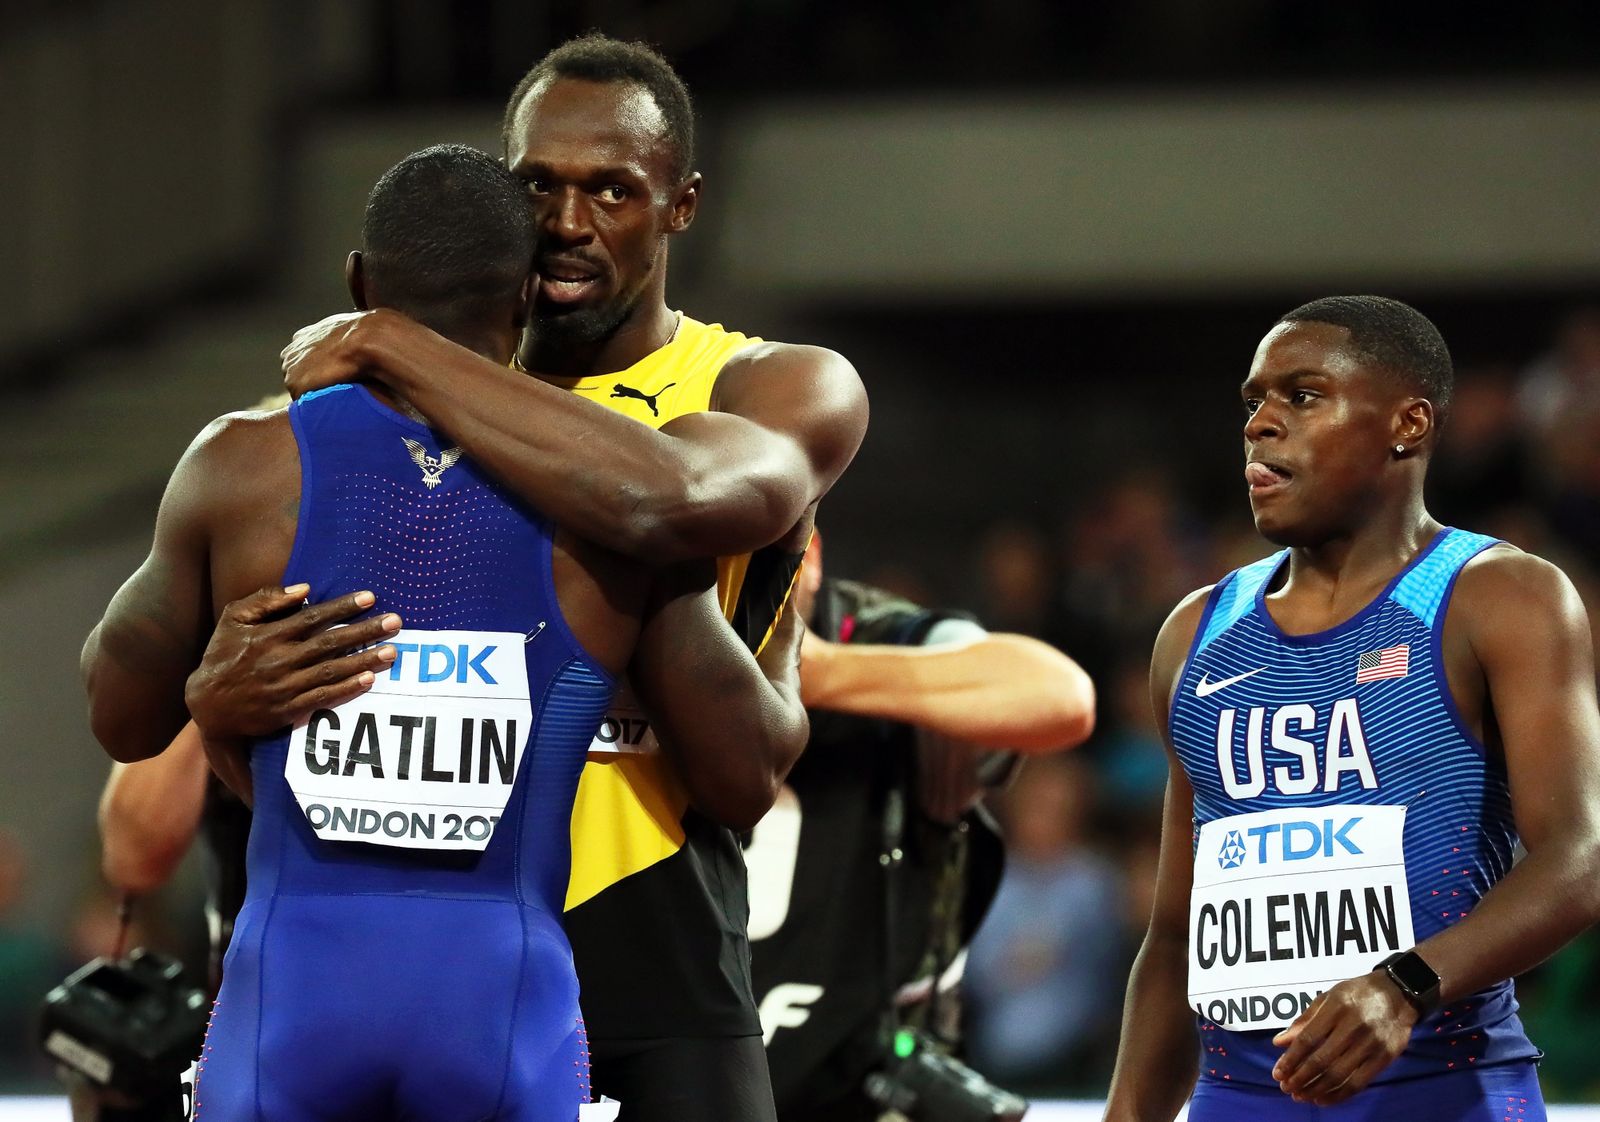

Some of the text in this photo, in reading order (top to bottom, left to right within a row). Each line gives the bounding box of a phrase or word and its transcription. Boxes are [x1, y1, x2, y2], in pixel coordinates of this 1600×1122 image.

[377, 641, 499, 685] TDK
[304, 708, 517, 785] GATLIN
[595, 716, 649, 746] 017
[1215, 697, 1381, 800] USA
[305, 803, 436, 840] ONDON
[1247, 816, 1365, 864] TDK
[1196, 885, 1400, 970] COLEMAN
